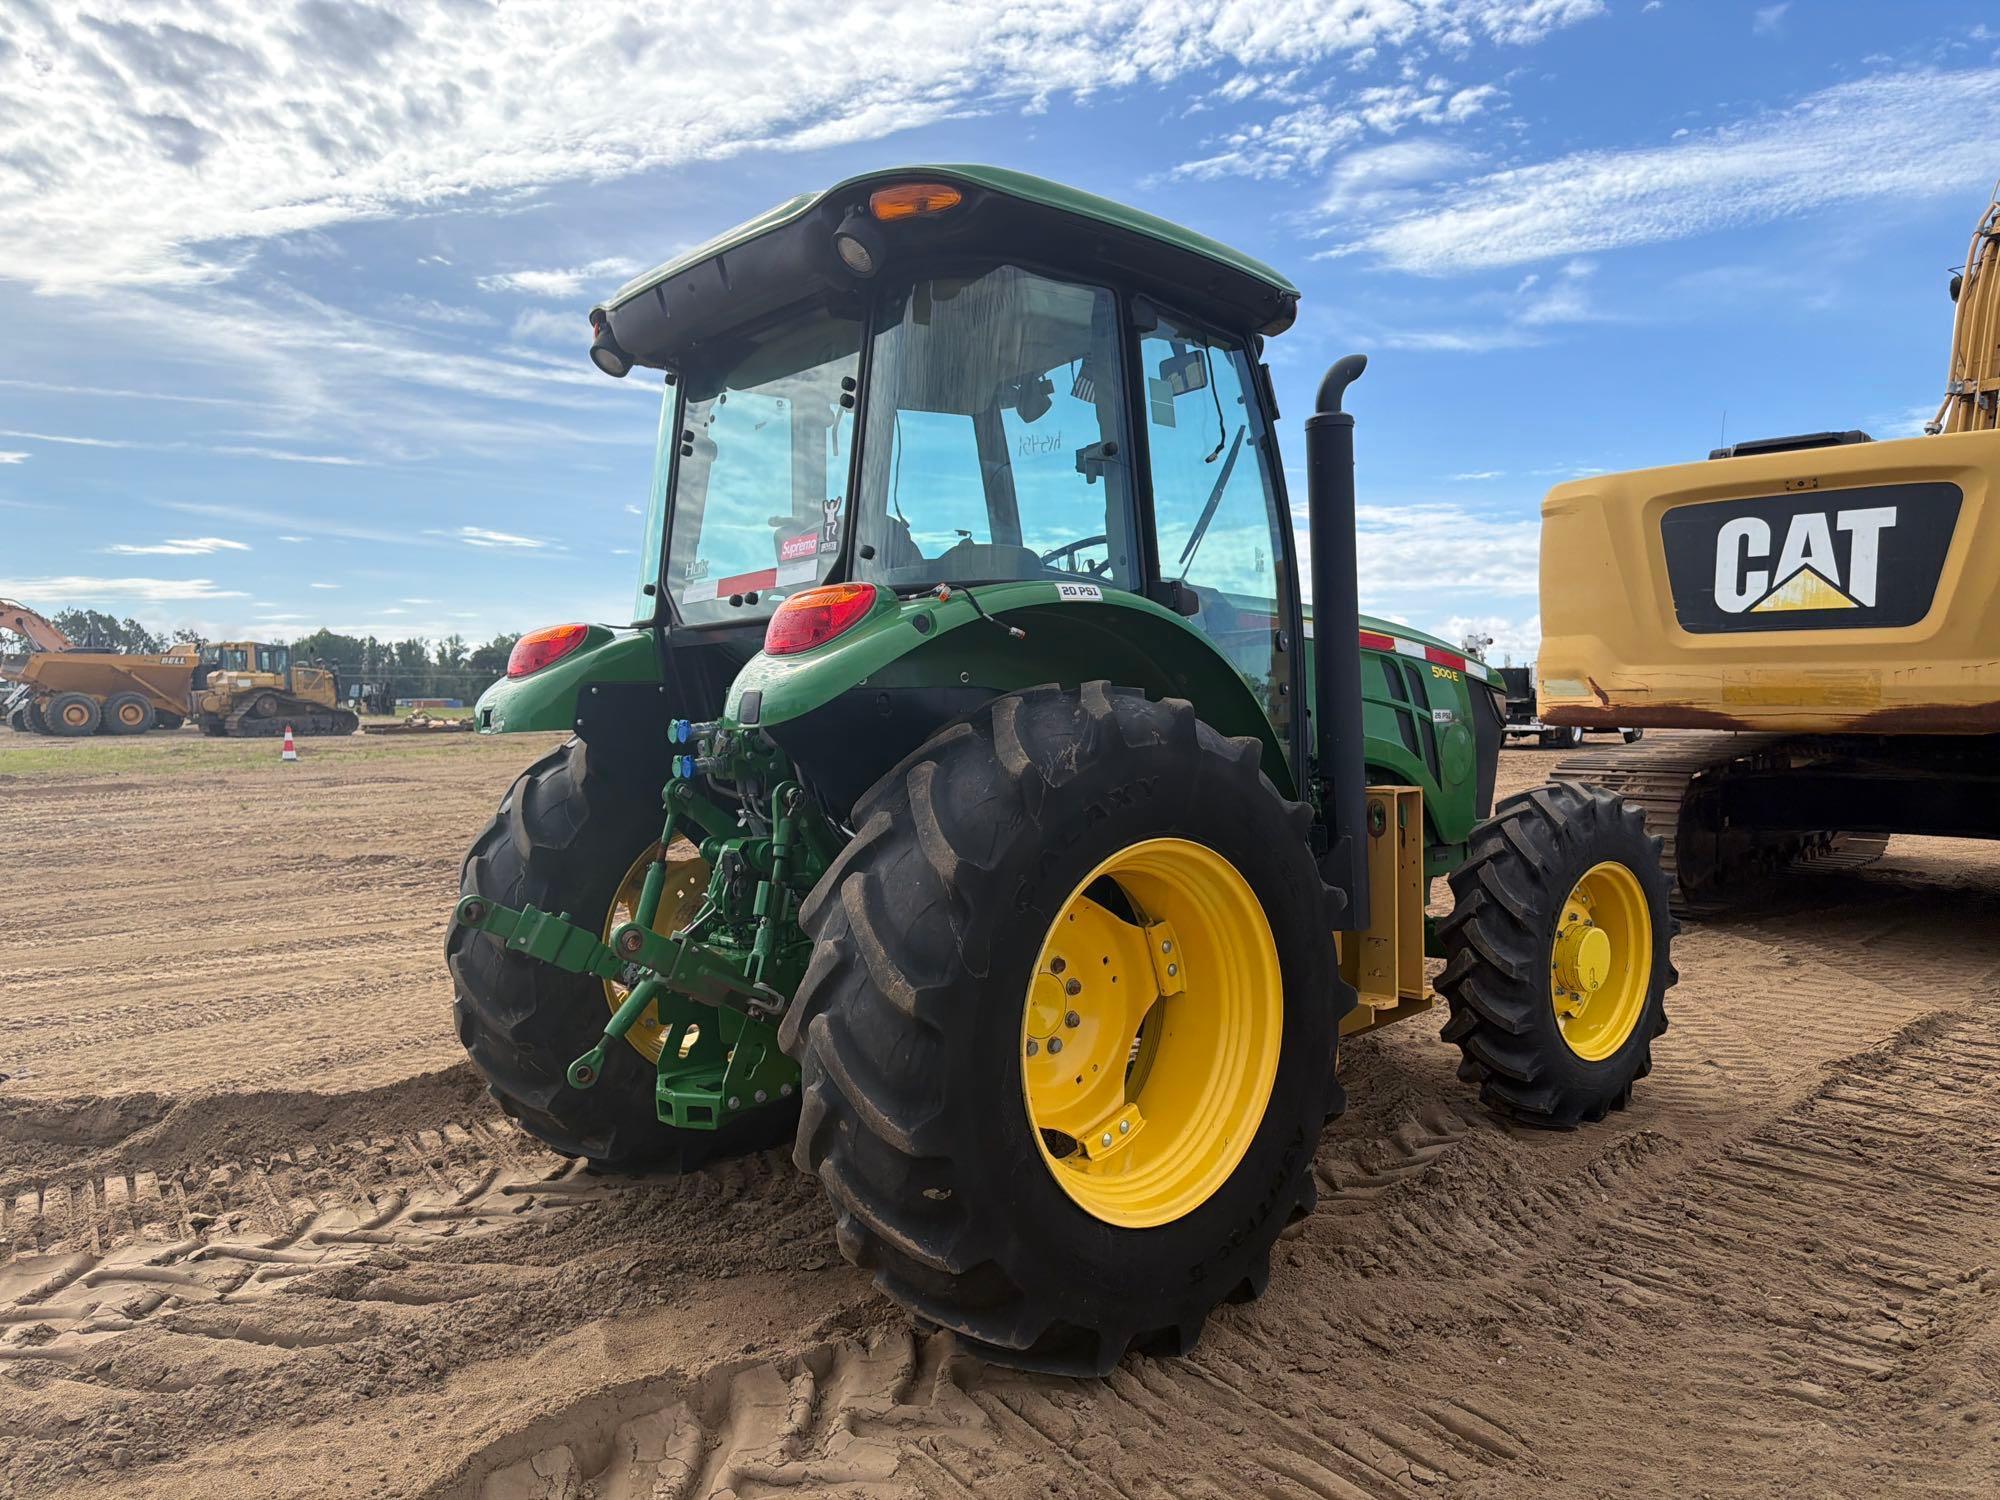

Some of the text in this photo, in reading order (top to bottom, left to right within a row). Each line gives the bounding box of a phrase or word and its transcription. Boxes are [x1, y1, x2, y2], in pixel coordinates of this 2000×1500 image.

[1713, 506, 1897, 613] CAT
[1061, 586, 1099, 596] 20 PSI
[161, 656, 186, 664] BELL
